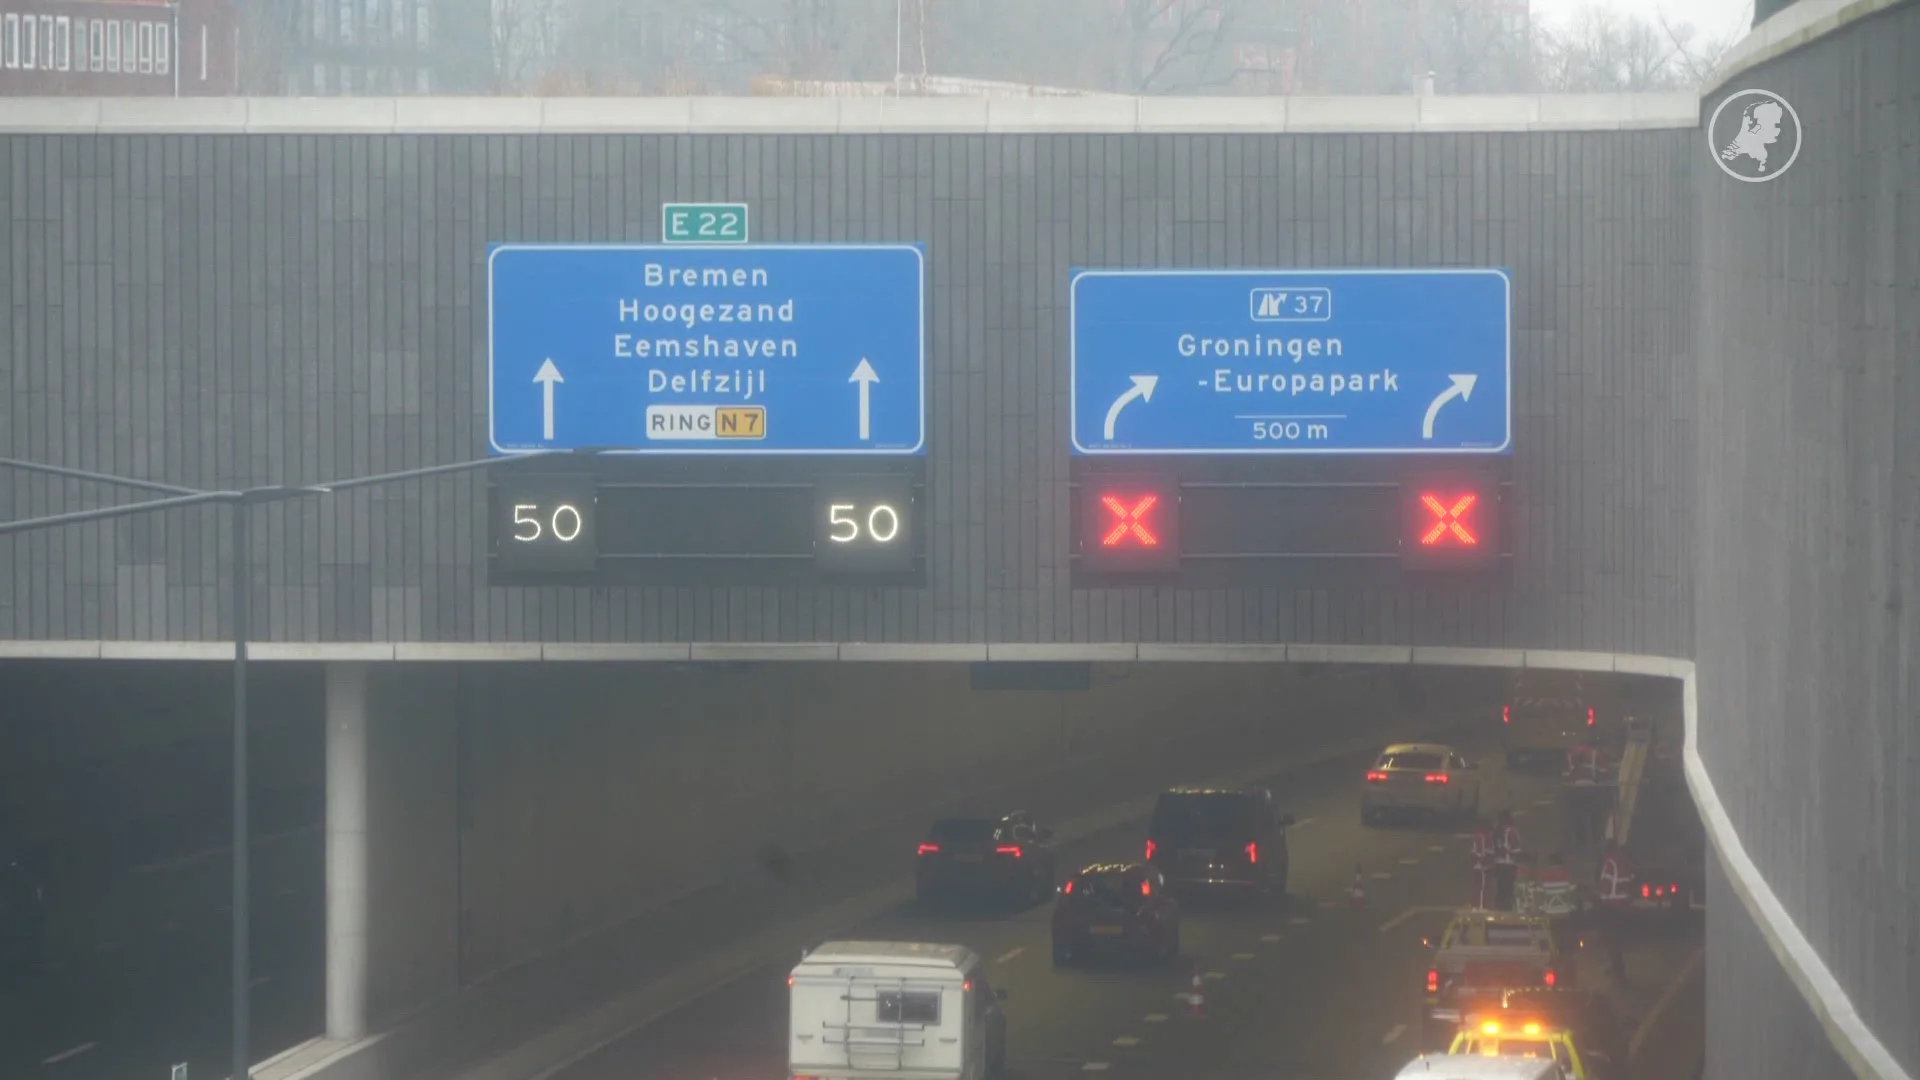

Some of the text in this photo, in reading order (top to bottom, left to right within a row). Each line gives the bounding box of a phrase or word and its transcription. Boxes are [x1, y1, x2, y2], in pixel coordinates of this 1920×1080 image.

[672, 212, 738, 235] E 22
[644, 263, 768, 287] Bremen
[619, 299, 794, 328] Hoogezand
[1294, 296, 1323, 314] 37
[614, 334, 798, 358] Eemshaven
[1178, 334, 1343, 362] Groningen
[648, 369, 766, 399] Delfzijl
[1198, 369, 1398, 396] -Europapark
[652, 414, 711, 432] RING
[1253, 422, 1328, 440] 500 m
[514, 504, 582, 542] 50
[829, 504, 899, 542] 50
